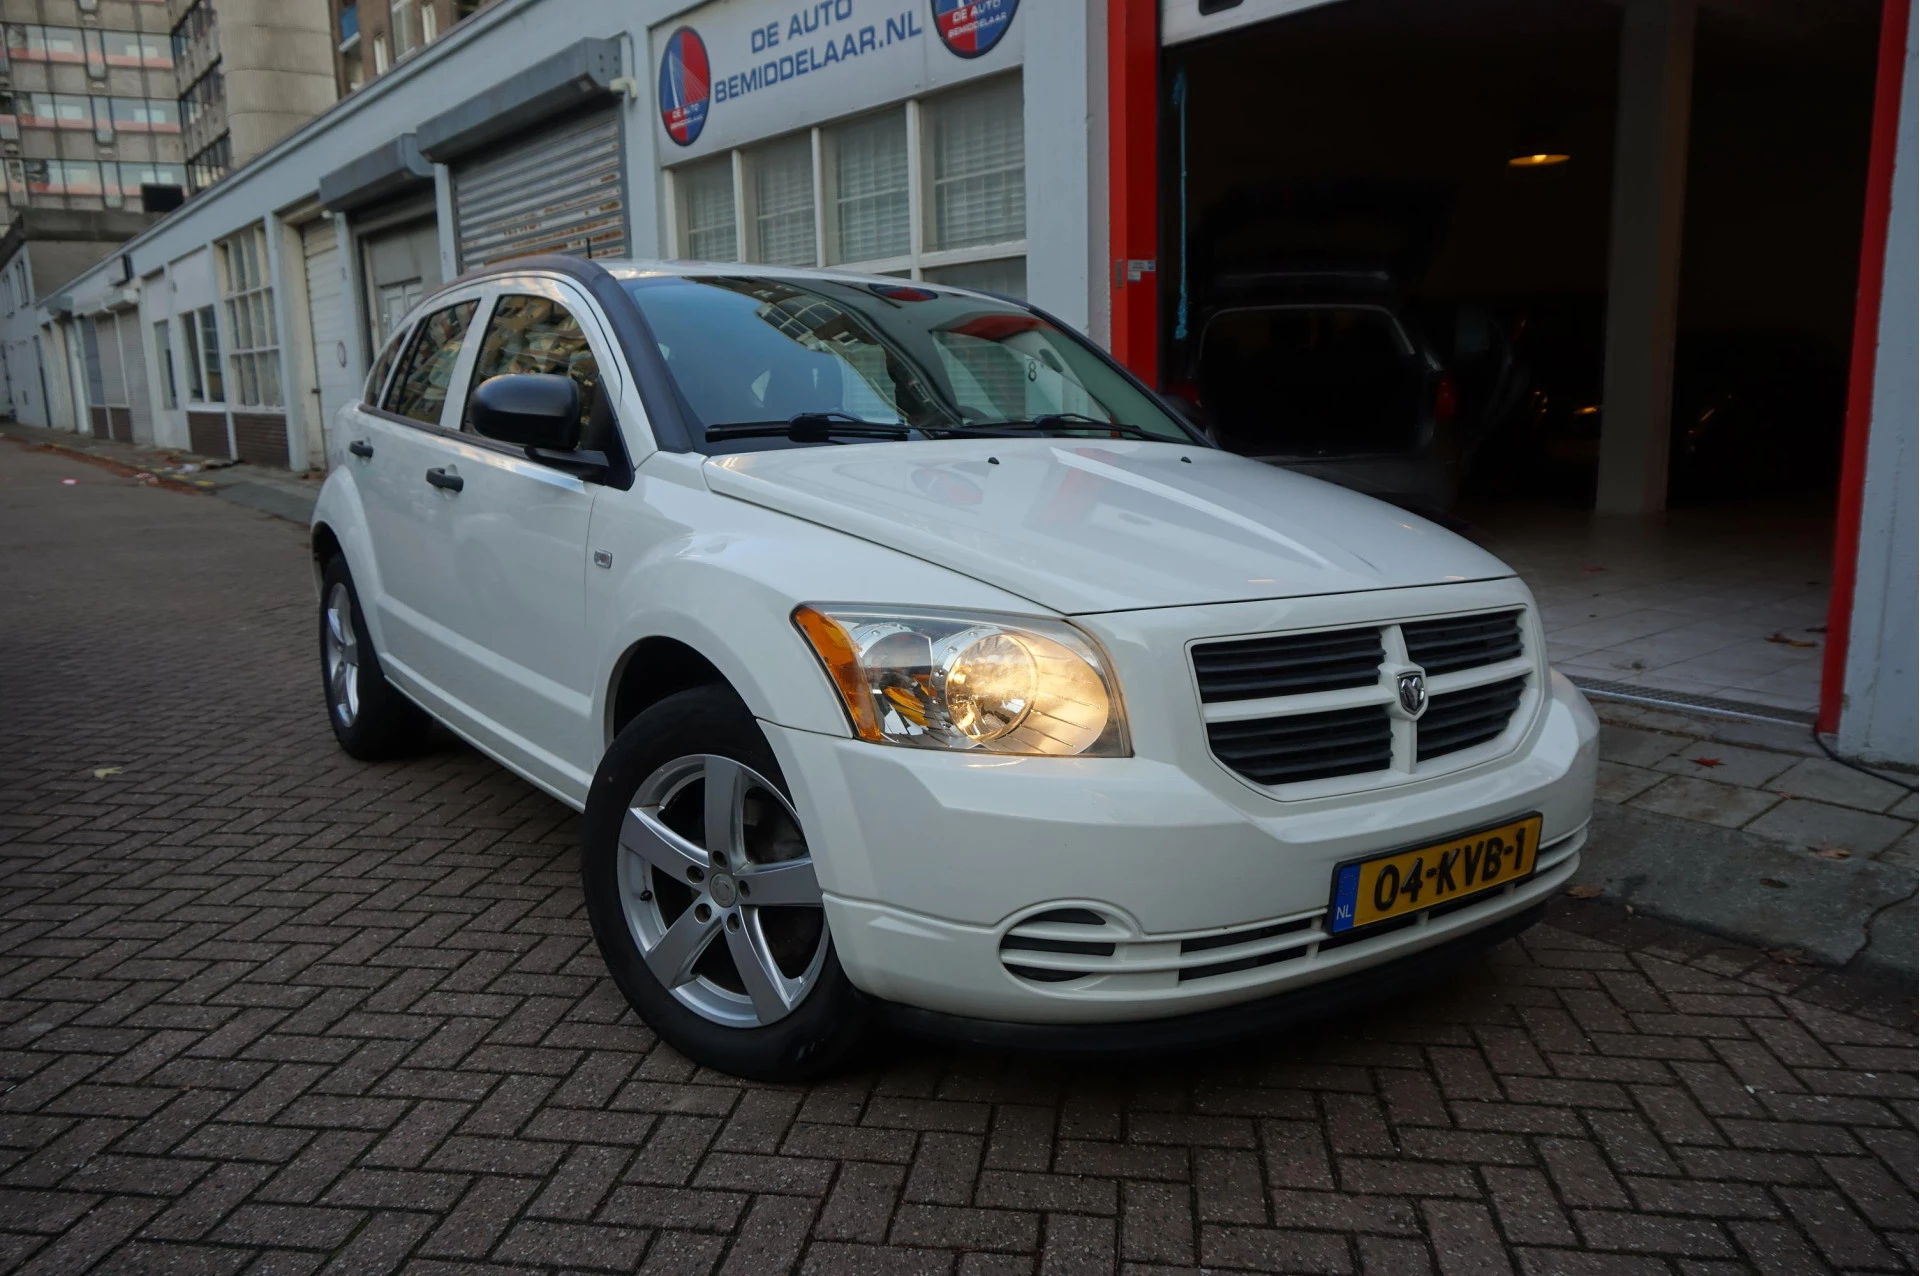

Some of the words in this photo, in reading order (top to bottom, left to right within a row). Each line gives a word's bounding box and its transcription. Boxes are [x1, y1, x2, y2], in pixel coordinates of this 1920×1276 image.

[751, 21, 779, 54] DE
[787, 0, 852, 41] AUTO
[952, 9, 968, 23] DE
[970, 0, 1000, 17] AUTO
[714, 10, 923, 103] BEMIDDELAAR.NL
[1028, 361, 1037, 382] 8
[1373, 828, 1526, 912] 04-KVB-1
[1336, 903, 1352, 921] NL
